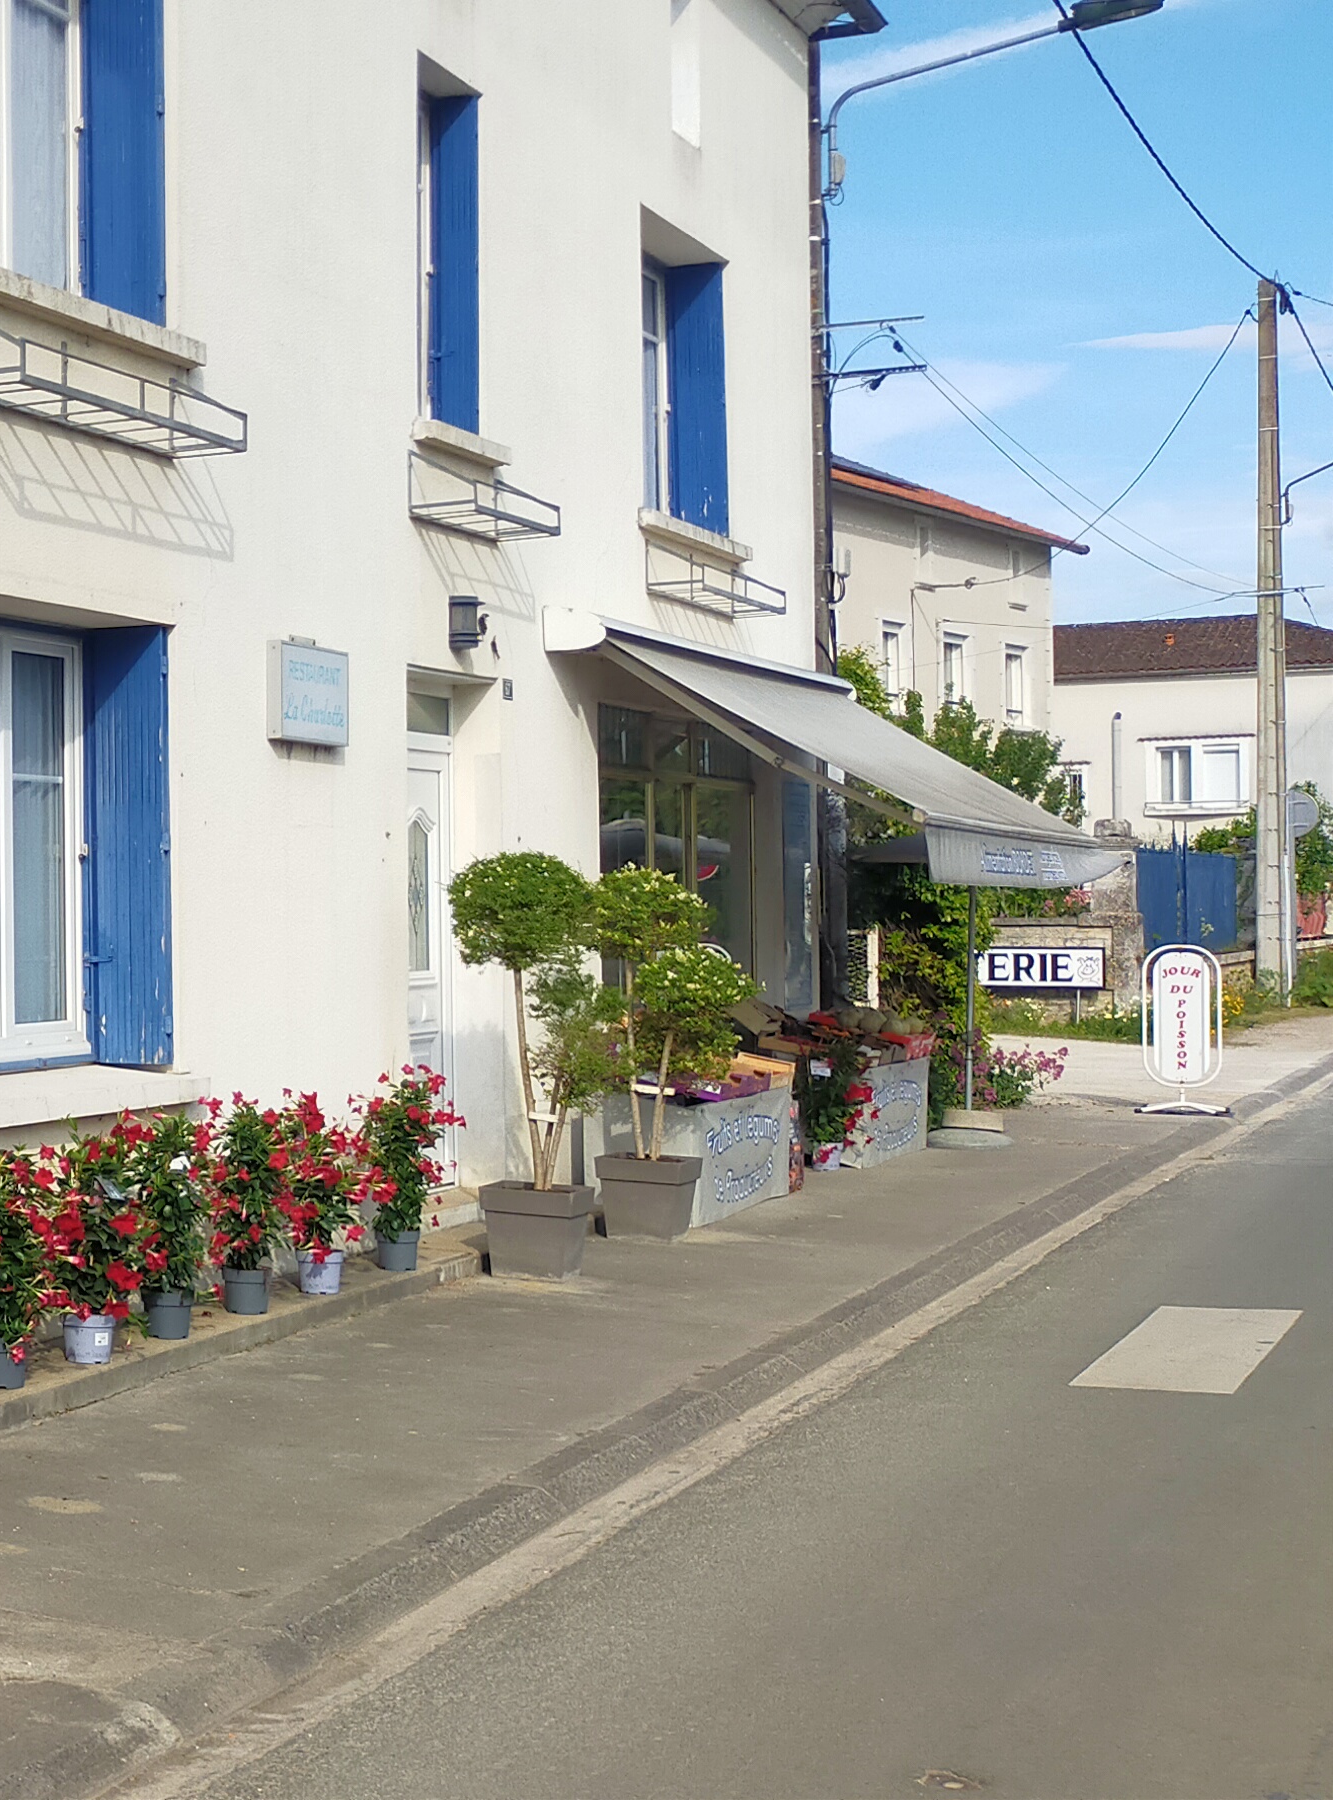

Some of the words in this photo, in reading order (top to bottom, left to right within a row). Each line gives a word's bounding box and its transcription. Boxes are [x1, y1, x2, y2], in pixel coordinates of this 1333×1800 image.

[288, 659, 341, 686] RESTAURANT
[1162, 966, 1201, 980] JOUR
[1170, 984, 1193, 994] DU
[1176, 999, 1187, 1070] POISSON
[706, 1117, 732, 1159] Fruits
[733, 1110, 743, 1143] et
